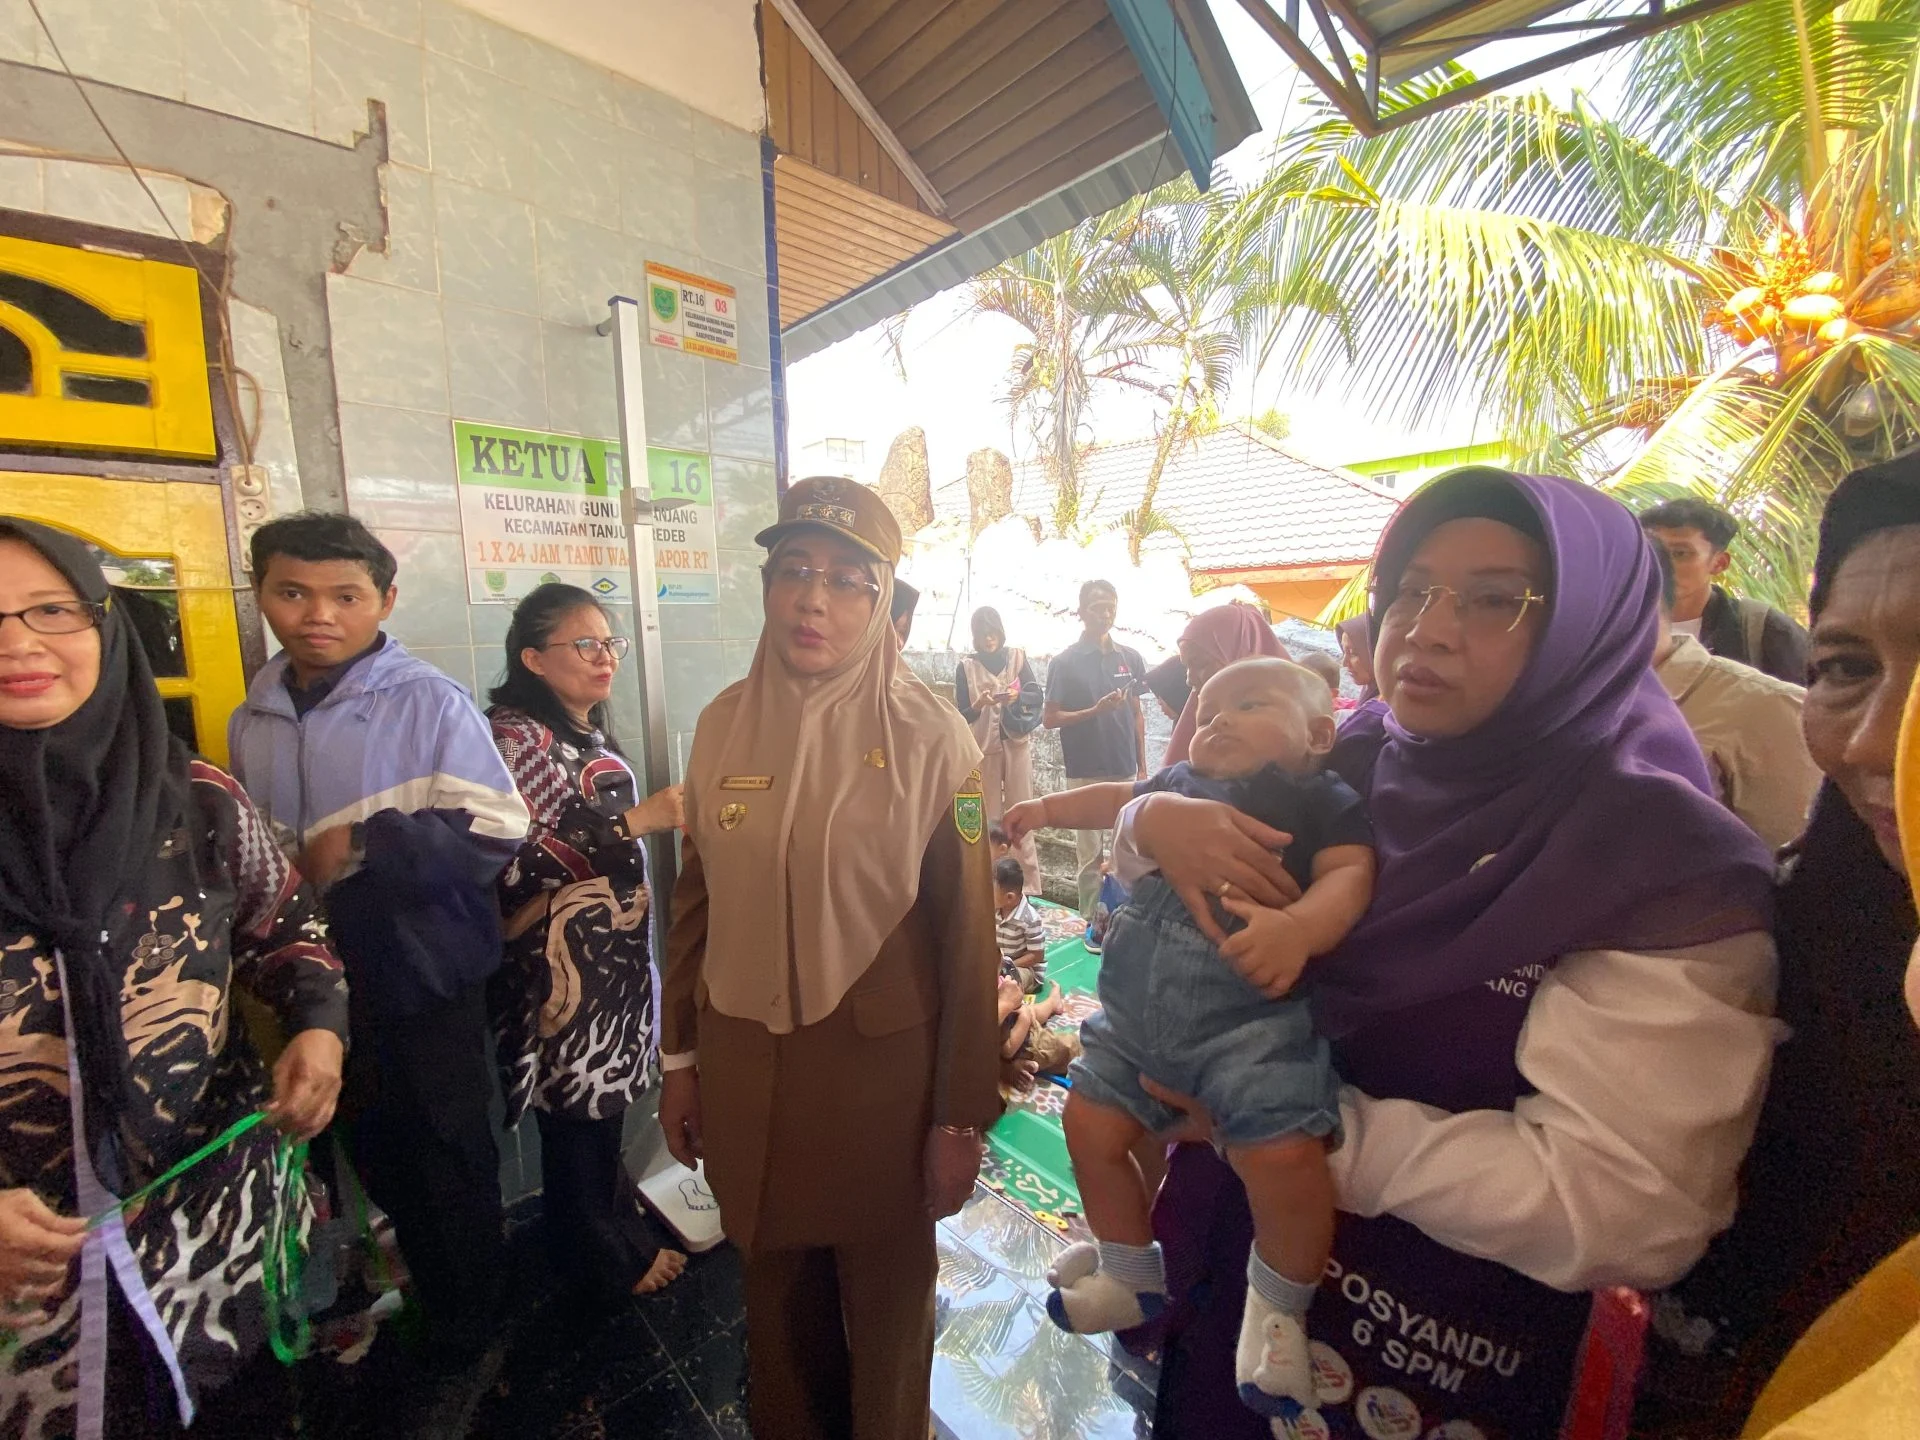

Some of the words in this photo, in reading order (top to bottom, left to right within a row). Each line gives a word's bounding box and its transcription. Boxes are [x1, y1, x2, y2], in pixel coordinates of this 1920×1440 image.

[682, 289, 704, 307] RT.16
[715, 298, 727, 314] 03
[470, 434, 596, 485] KETUA
[670, 459, 702, 496] 16
[483, 492, 577, 515] KELURAHAN
[504, 517, 587, 537] KECAMATAN
[479, 540, 487, 562] 1
[491, 541, 505, 563] X
[508, 541, 526, 563] 24
[531, 543, 562, 565] JAM
[564, 544, 604, 567] TAMU
[693, 551, 709, 570] RT
[1352, 1317, 1376, 1347] 6
[1381, 1338, 1467, 1394] SPM
